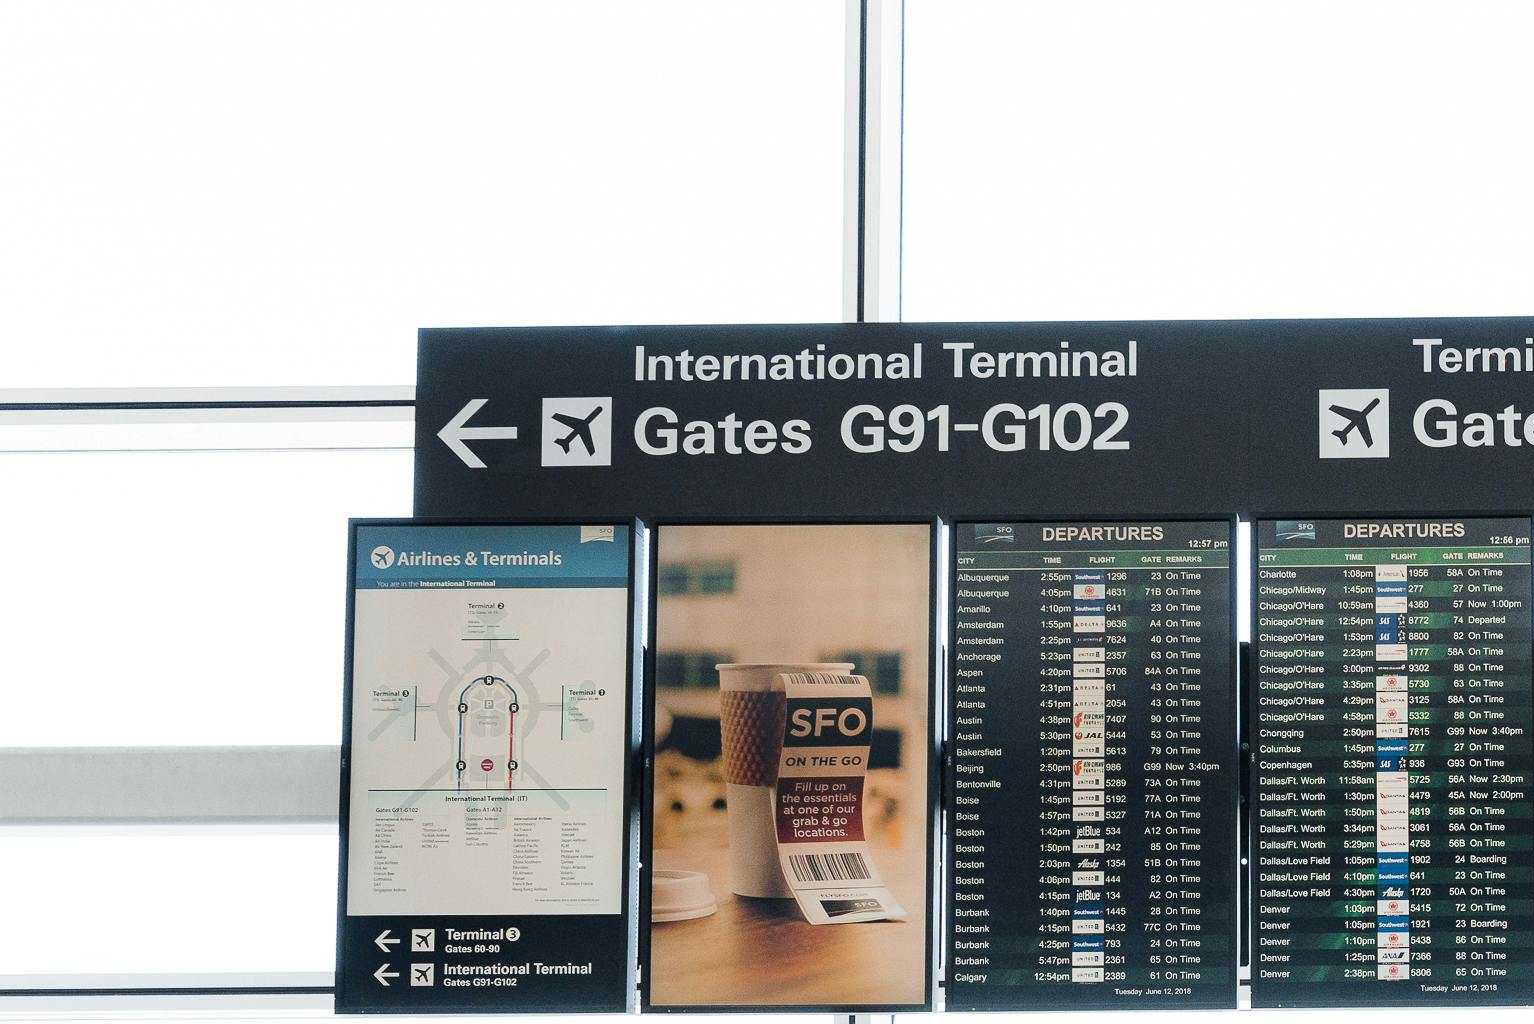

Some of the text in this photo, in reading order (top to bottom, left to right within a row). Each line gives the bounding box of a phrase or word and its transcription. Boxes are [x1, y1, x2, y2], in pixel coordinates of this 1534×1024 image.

[634, 341, 1137, 382] International Terminal
[634, 402, 1130, 456] Gates G91-G102
[1042, 527, 1164, 541] DEPARTURES
[1344, 523, 1465, 538] DEPARTURES
[1188, 540, 1228, 549] 12:57 pm
[397, 551, 561, 566] Airlines & Terminals
[958, 557, 974, 565] CITY
[1089, 556, 1115, 564] FLIGHT
[1260, 617, 1324, 627] Chicago/O'Hare
[1338, 617, 1374, 626] 12:54pm
[1379, 617, 1390, 625] SAS
[1468, 616, 1505, 625] Departed
[789, 708, 867, 737] SFO
[785, 756, 862, 767] ON THE GO
[1260, 777, 1299, 786] Dallas/Ft.
[1302, 777, 1325, 785] Worth
[1339, 776, 1374, 785] 11:58am
[1448, 775, 1465, 783] 56A
[1470, 775, 1488, 783] Now
[1493, 775, 1523, 784] 2:30pm
[795, 783, 846, 793] Fill up on
[782, 793, 856, 803] the essentials
[784, 805, 855, 814] at one of our
[792, 817, 848, 828] grab & go
[794, 827, 848, 838] locations.
[956, 828, 984, 837] Boston
[1040, 828, 1070, 838] 1:42pm
[1076, 826, 1100, 838] jetBlue
[1144, 827, 1161, 835] A12
[1165, 827, 1180, 835] On
[1183, 827, 1200, 835] Time
[445, 929, 503, 940] Terminal
[445, 945, 500, 953] Gates 60-90
[444, 963, 592, 975] International Terminal
[444, 978, 517, 987] Gates G91-G102
[1115, 988, 1142, 996] Tuesday
